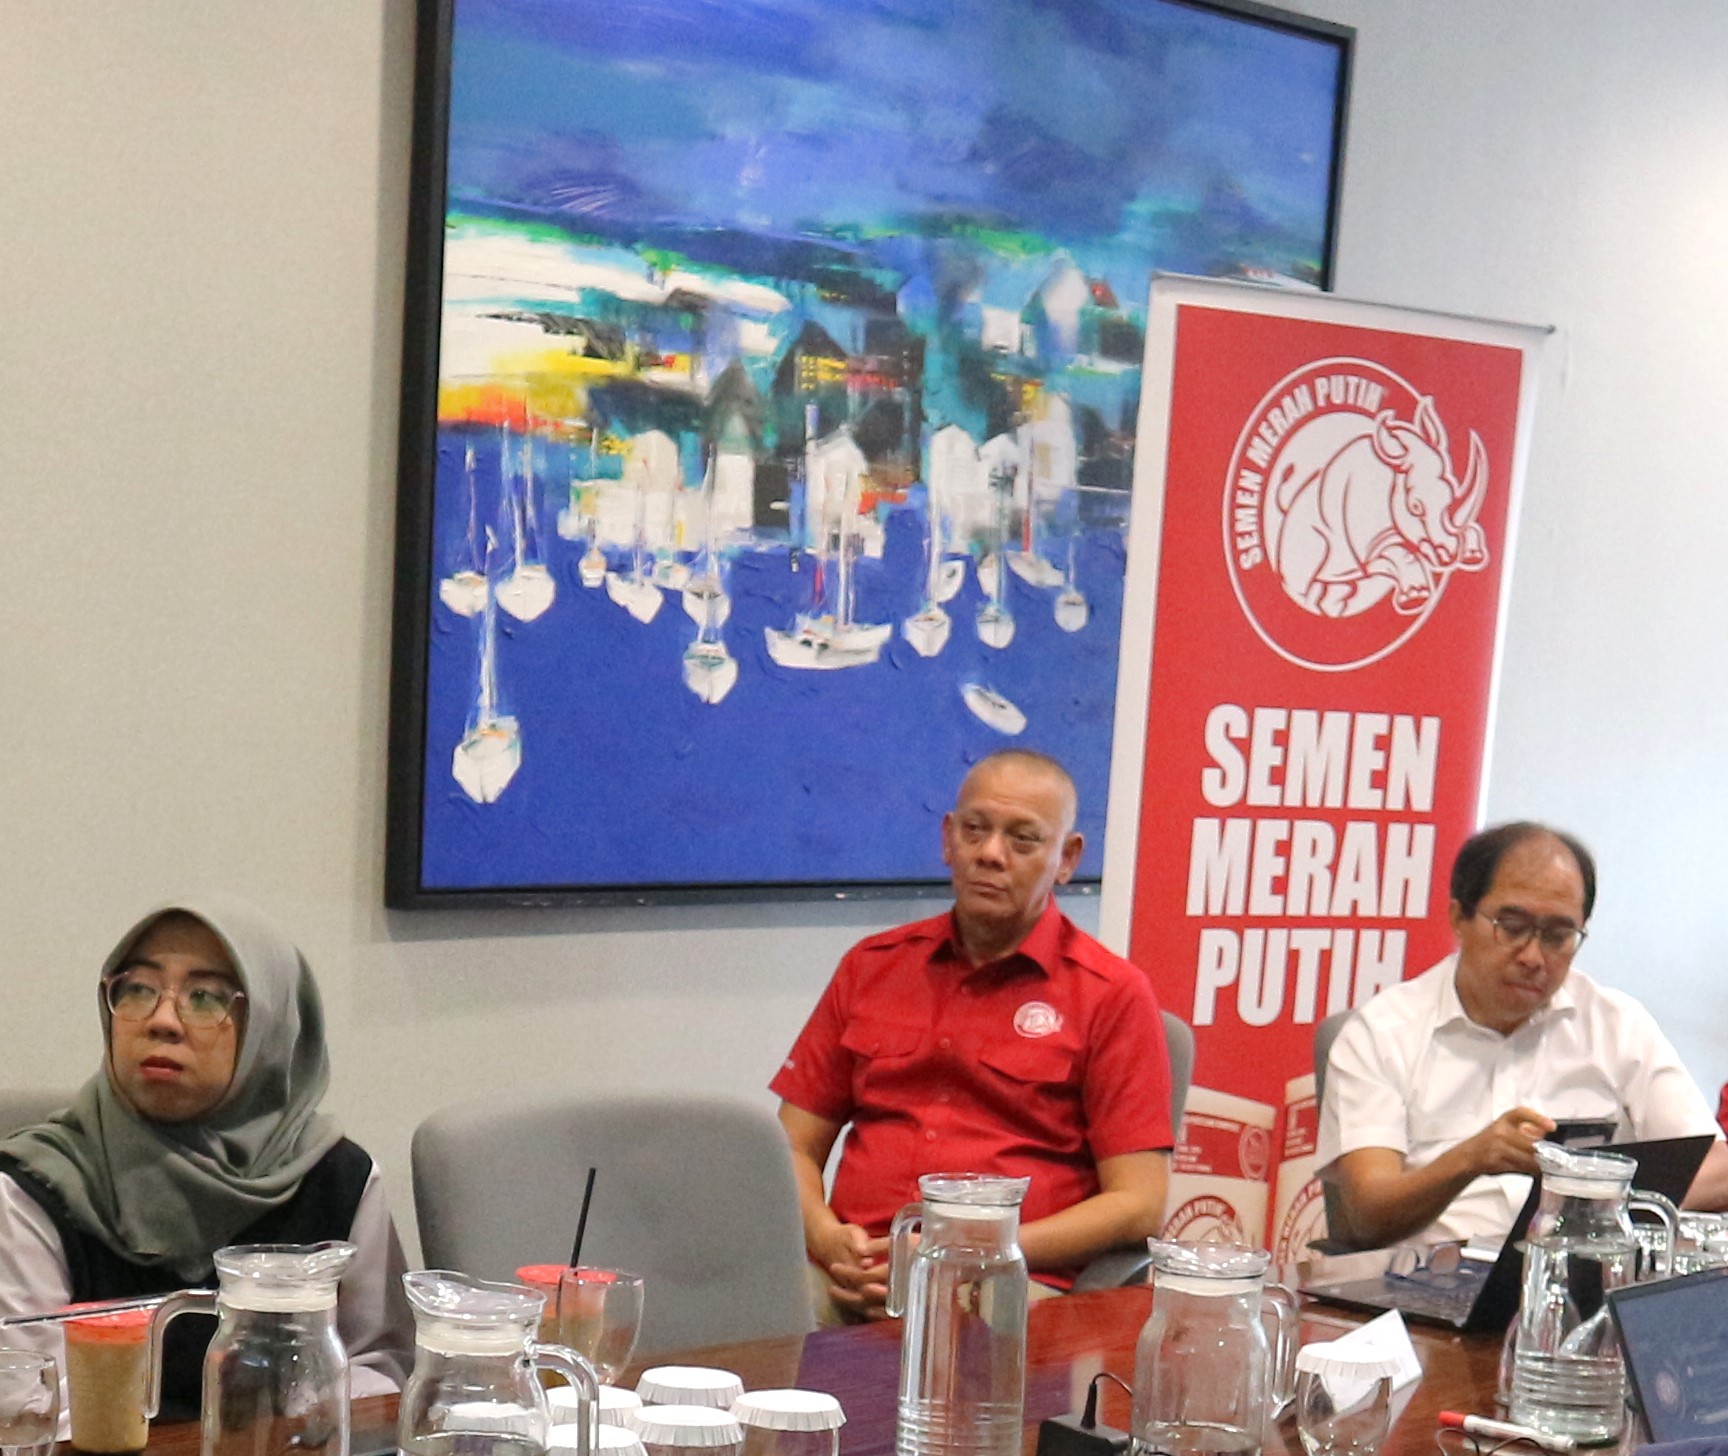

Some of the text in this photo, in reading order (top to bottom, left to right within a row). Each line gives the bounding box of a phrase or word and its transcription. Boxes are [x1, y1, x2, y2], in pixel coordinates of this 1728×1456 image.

[1234, 374, 1384, 570] SEMEN MERAH PUTIH
[1201, 703, 1441, 813] SEMEN
[1185, 817, 1437, 919] MERAH
[1192, 928, 1408, 1026] PUTIH
